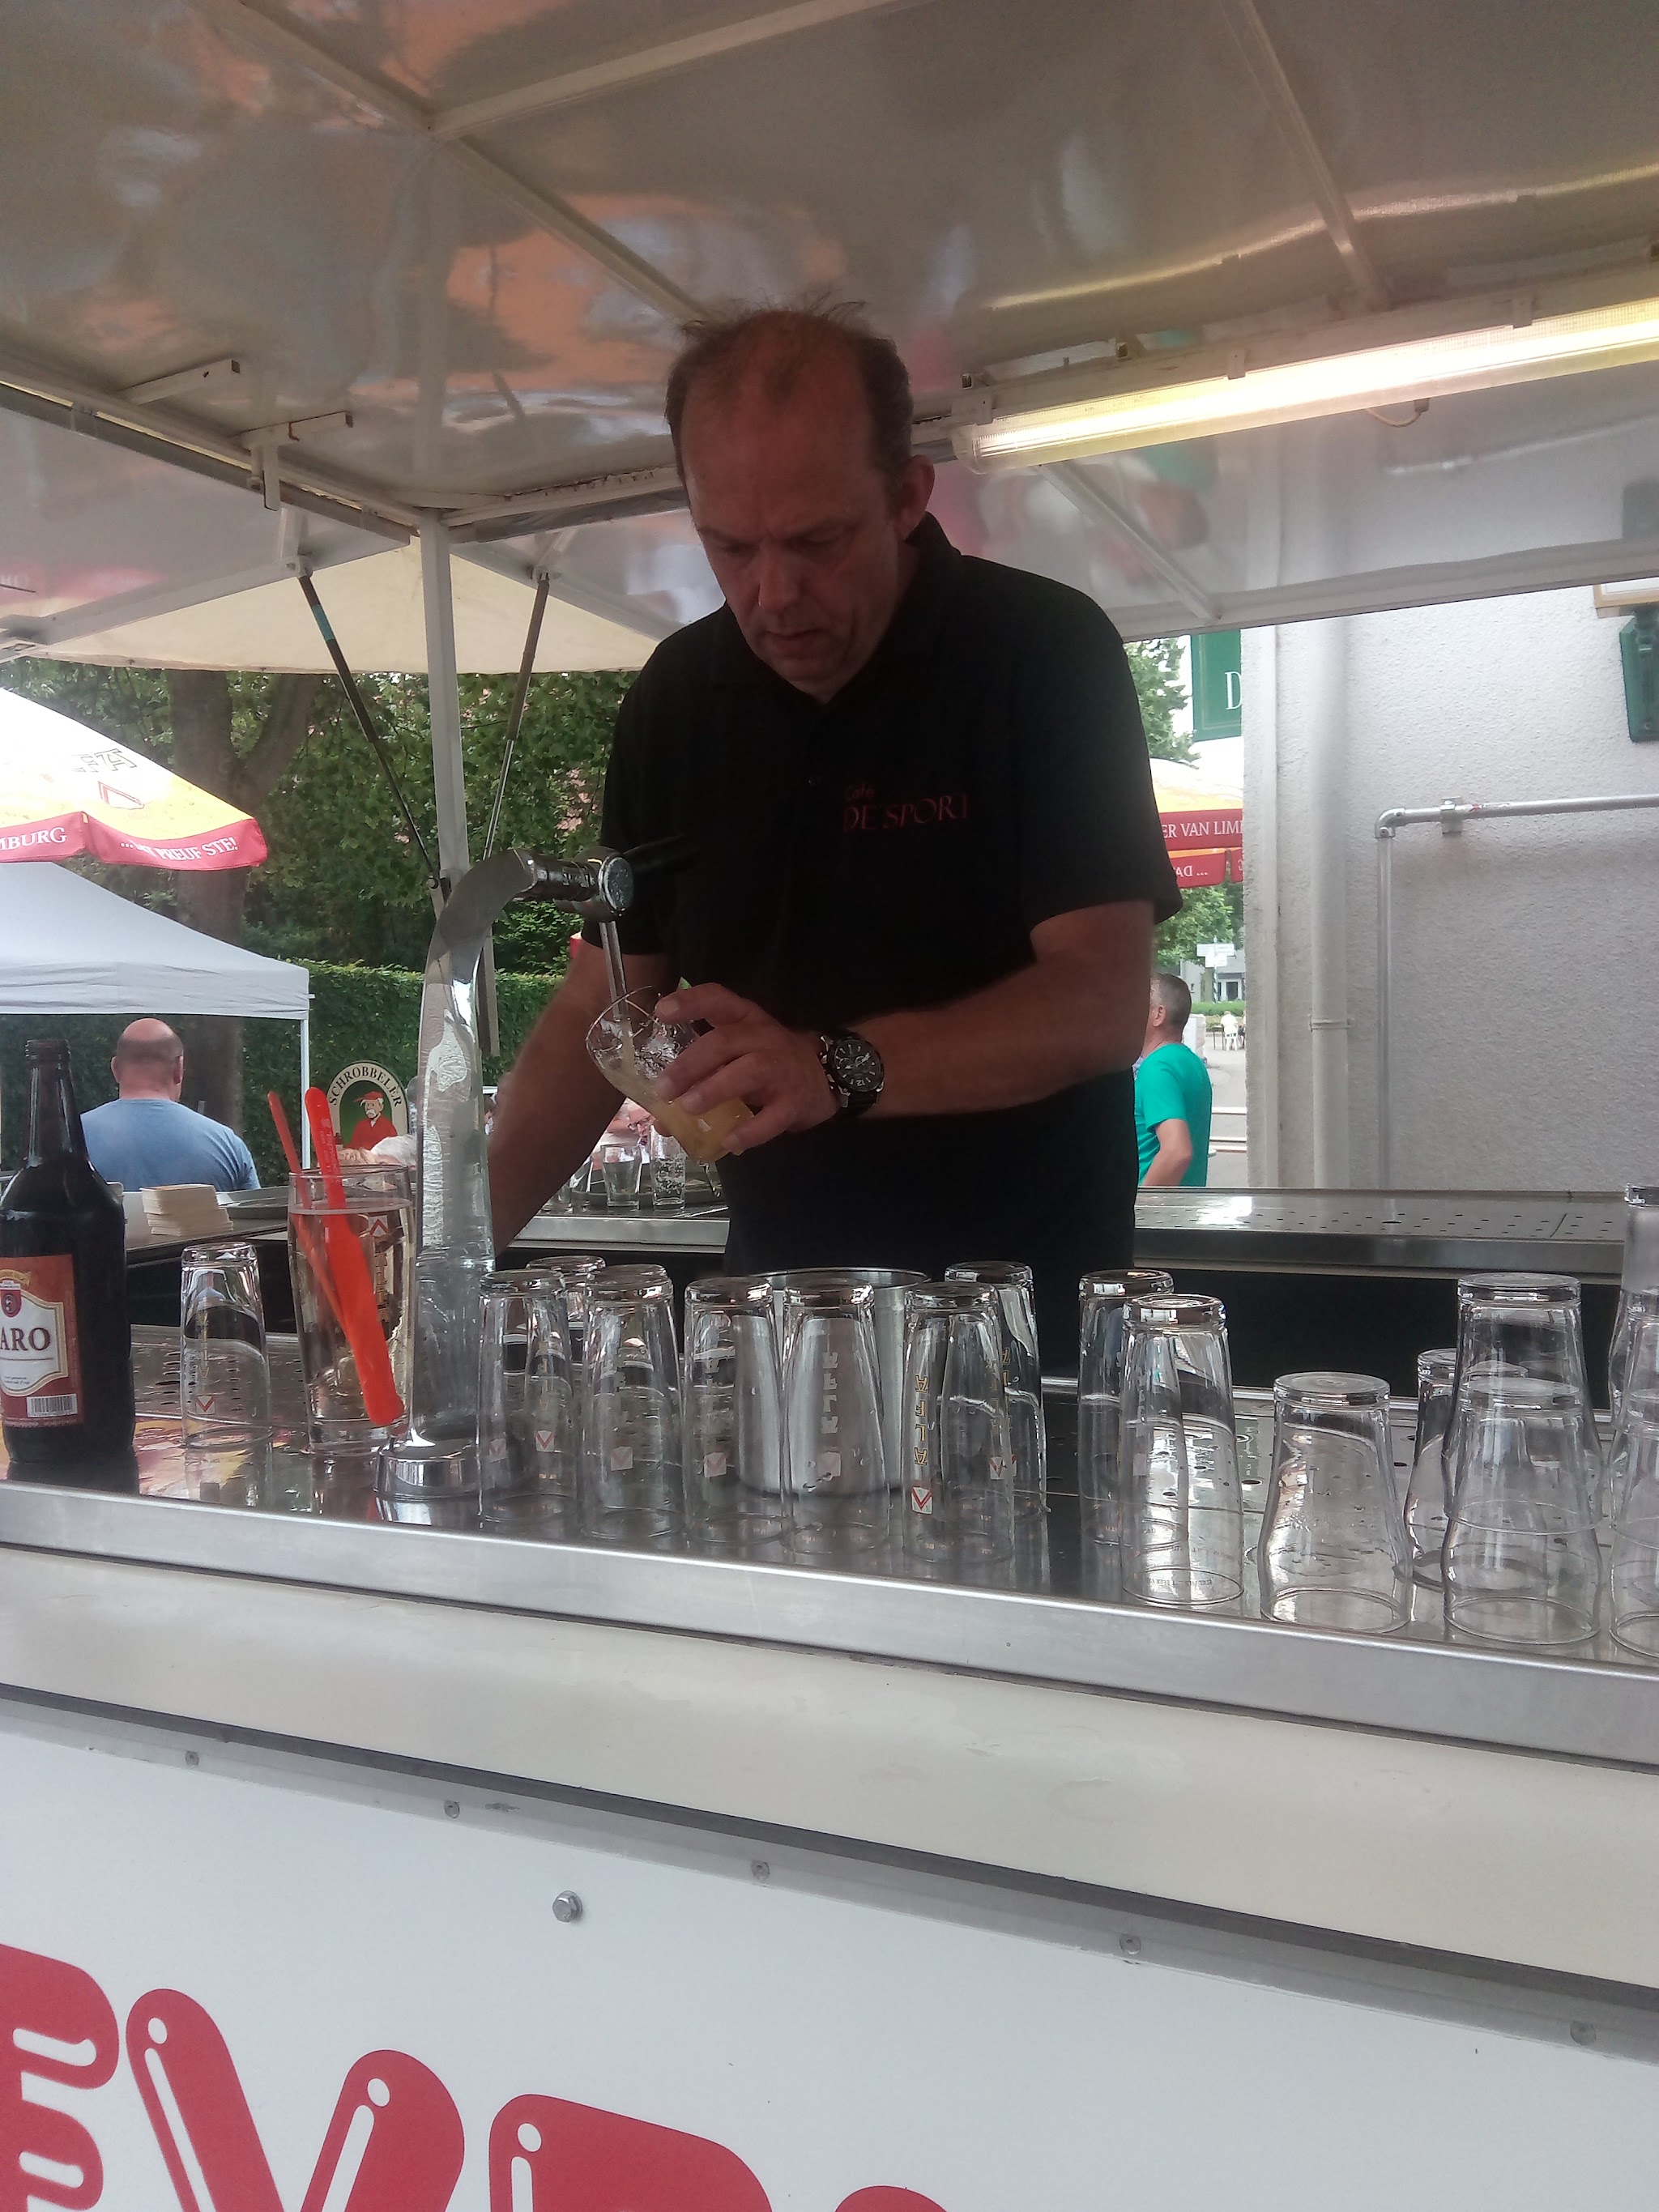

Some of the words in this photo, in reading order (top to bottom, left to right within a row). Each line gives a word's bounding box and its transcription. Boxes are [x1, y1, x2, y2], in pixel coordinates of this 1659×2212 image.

[1180, 821, 1210, 837] VAN
[329, 1066, 403, 1107] SCHROBBELER
[0, 1327, 50, 1351] ARO
[914, 1375, 929, 1466] ALFA
